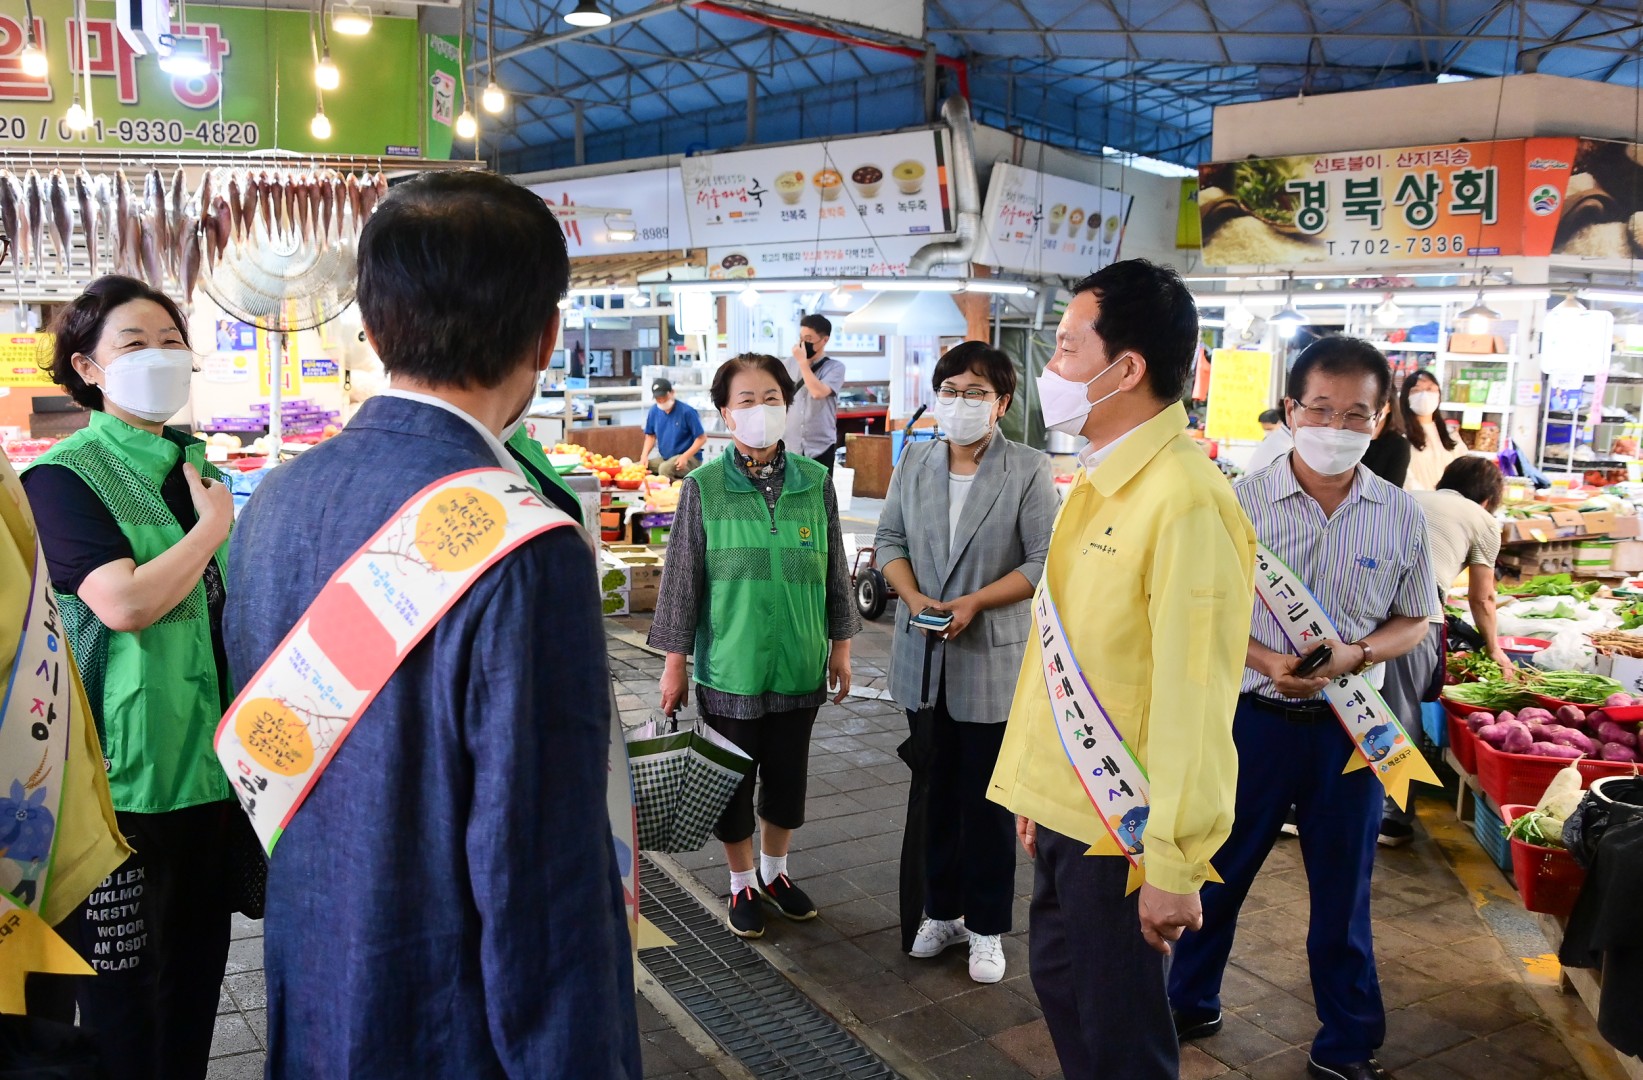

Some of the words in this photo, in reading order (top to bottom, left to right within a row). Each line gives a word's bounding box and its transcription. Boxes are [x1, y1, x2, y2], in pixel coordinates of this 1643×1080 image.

[1397, 147, 1469, 168] 산지직송
[1288, 166, 1498, 234] 경북상회
[117, 866, 145, 886] LEX
[88, 884, 144, 906] UKLMO
[86, 901, 140, 921] FARSTV
[94, 941, 111, 955] AN
[91, 955, 140, 971] TOLAD
